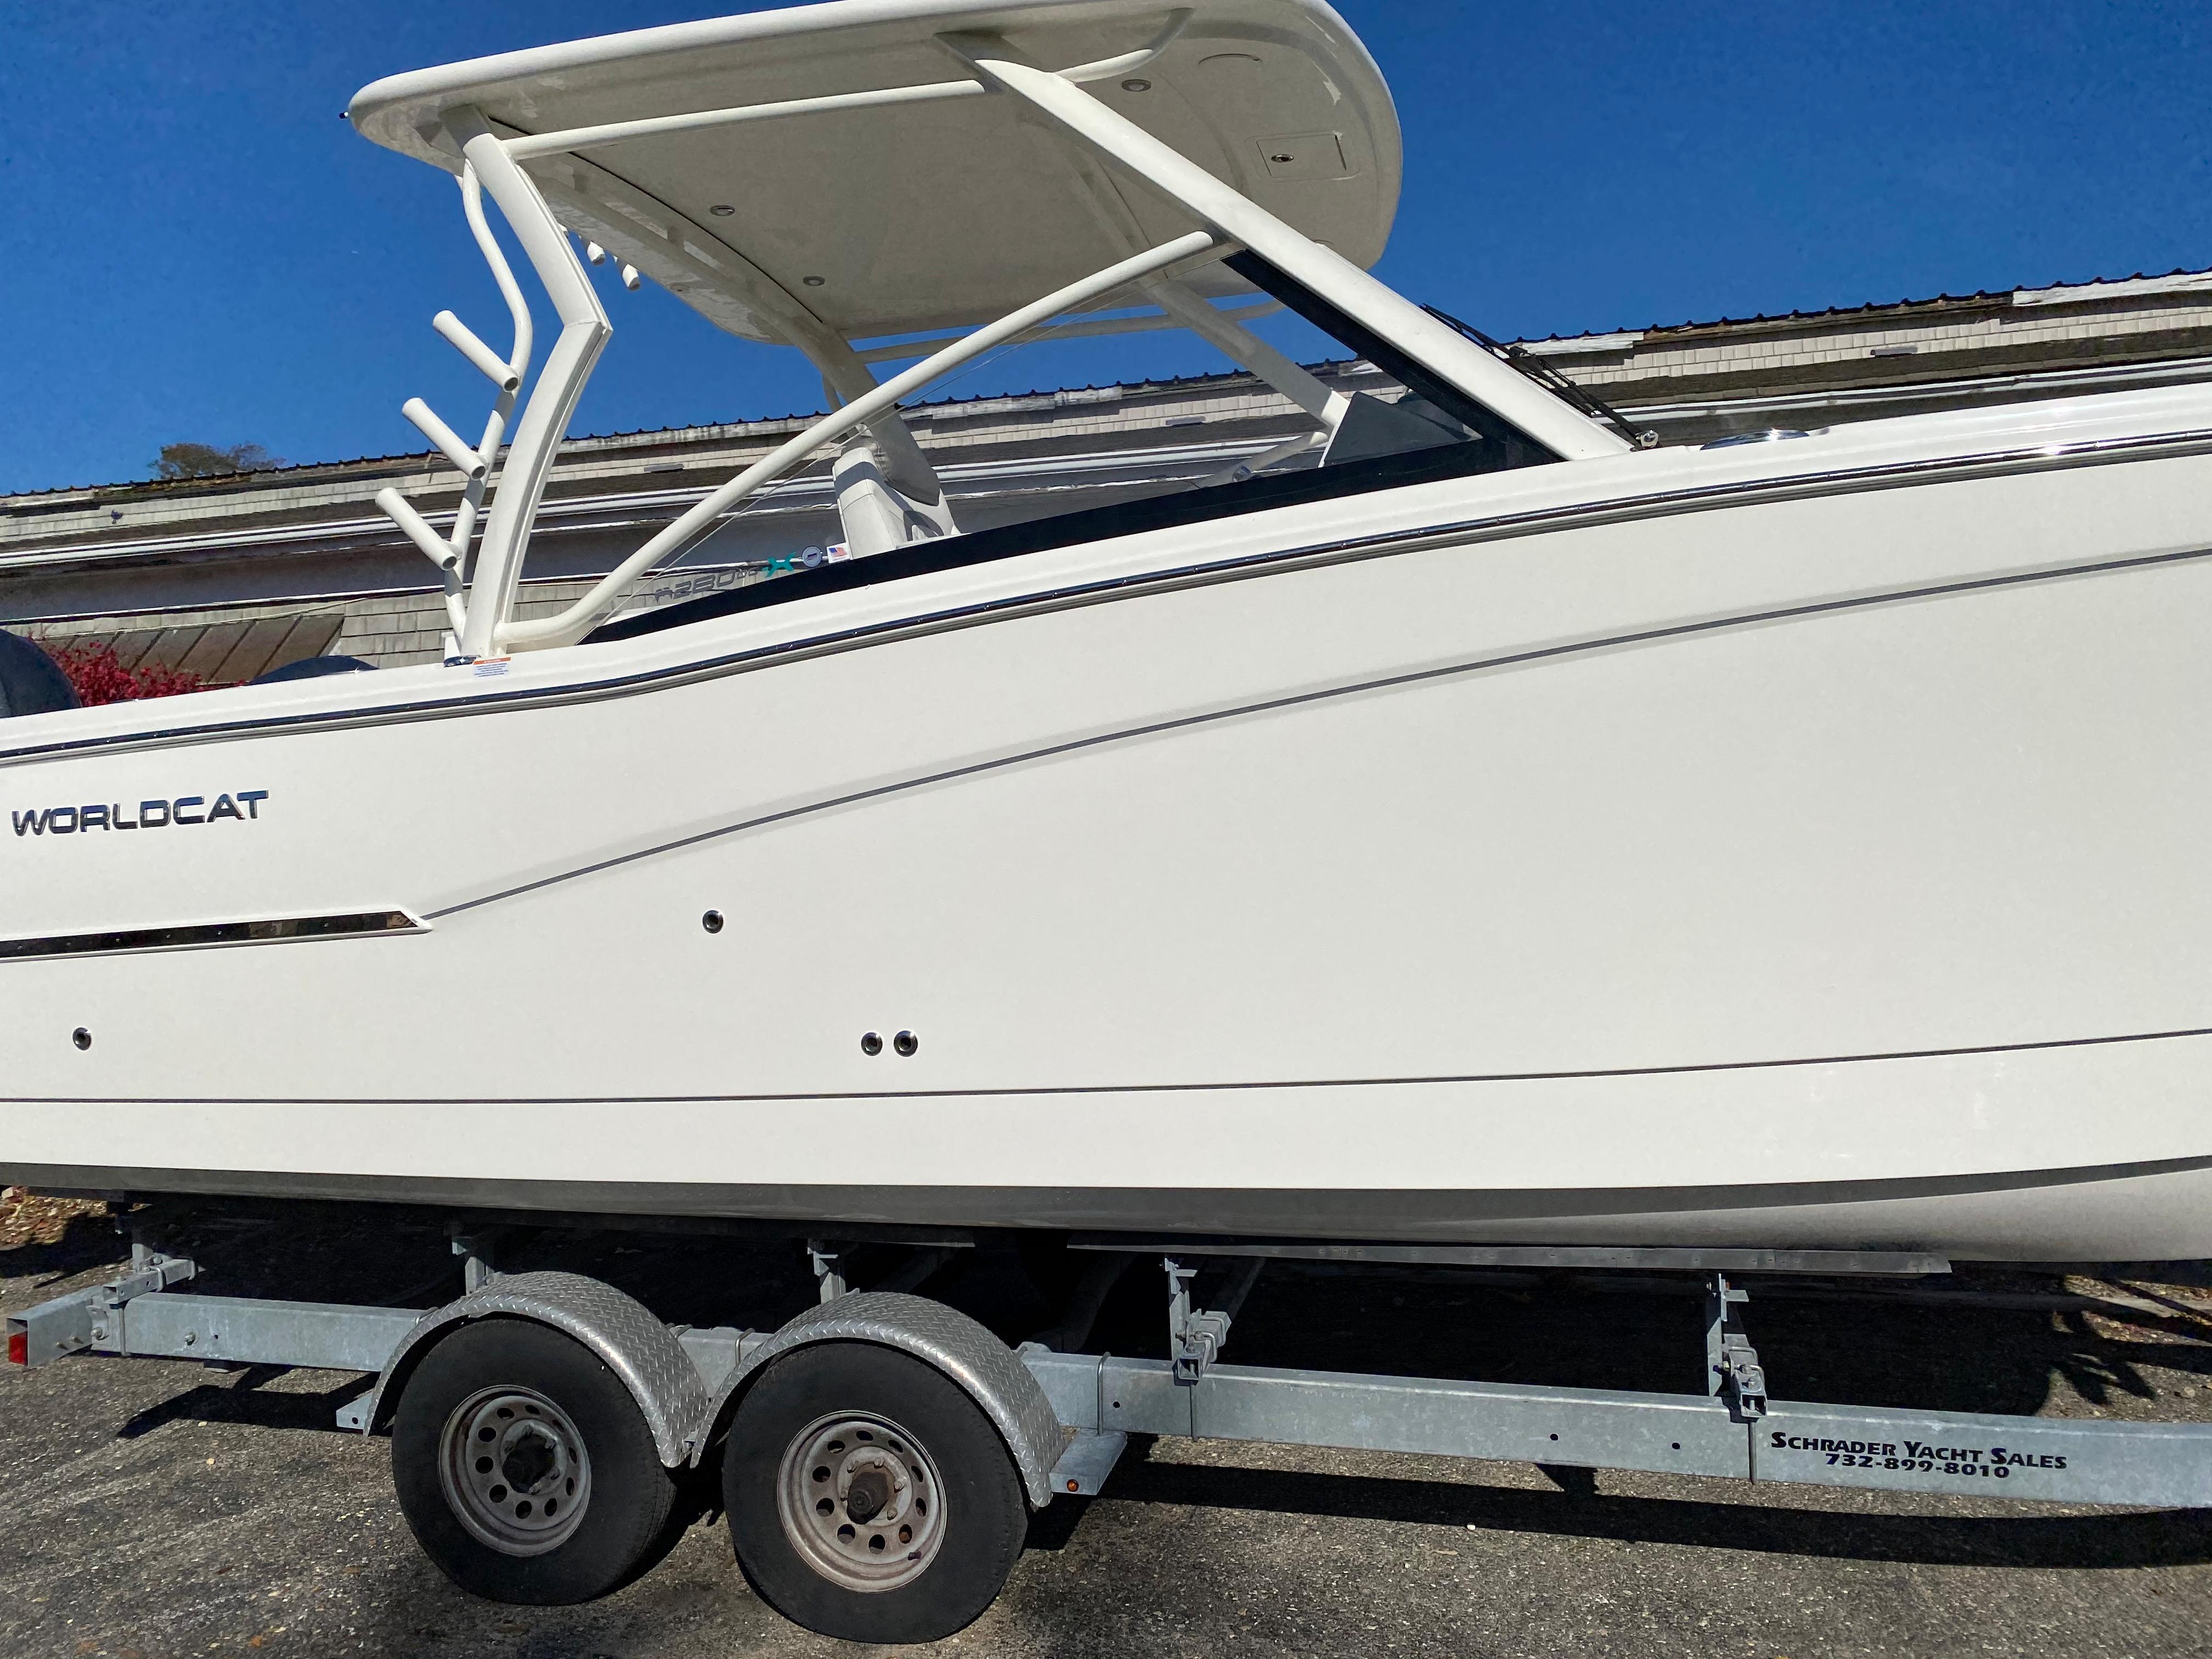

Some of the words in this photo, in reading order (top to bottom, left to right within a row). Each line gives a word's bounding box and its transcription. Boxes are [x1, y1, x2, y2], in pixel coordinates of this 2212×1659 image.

[12, 790, 269, 837] WORLDCAT
[1771, 1431, 1897, 1456] SCHRADER
[1903, 1441, 1983, 1463] YACHT
[1990, 1447, 2067, 1469] SALES
[1825, 1453, 2010, 1479] 732-899-8010
